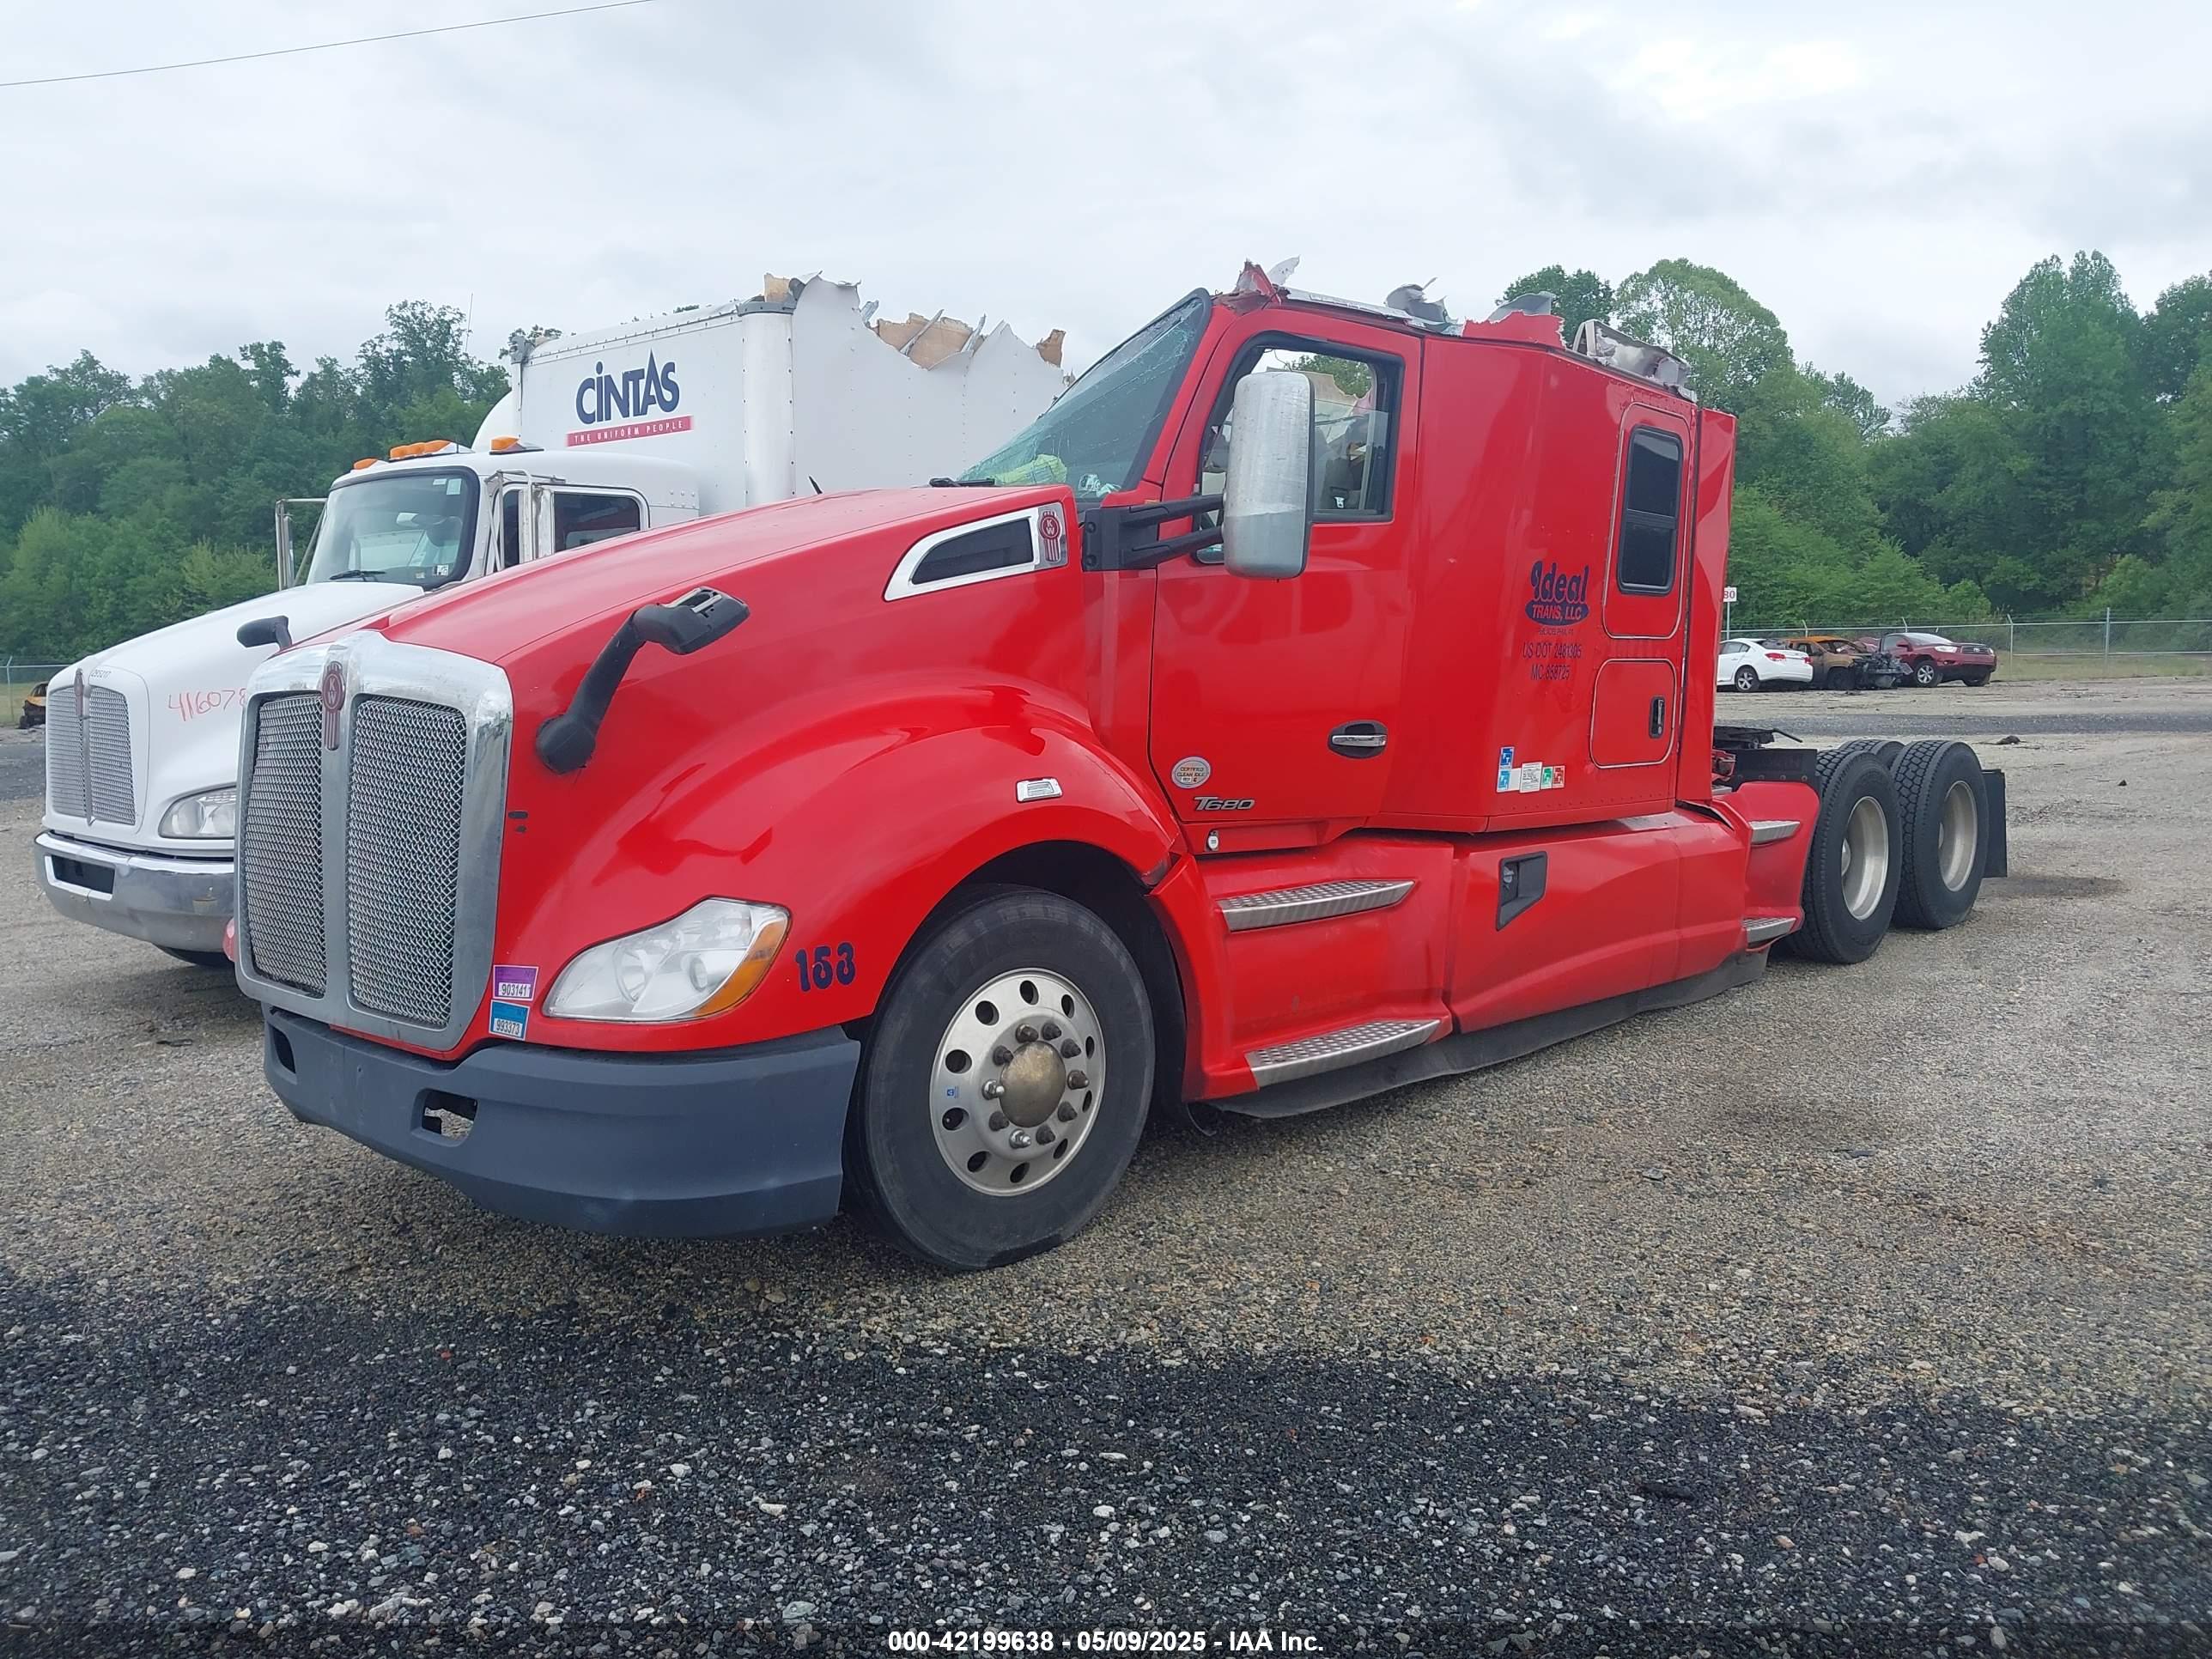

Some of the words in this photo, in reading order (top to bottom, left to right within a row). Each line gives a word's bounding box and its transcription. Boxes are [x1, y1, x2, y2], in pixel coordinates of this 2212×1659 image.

[574, 434, 591, 444] THE
[597, 427, 640, 441] UNIFORM
[646, 421, 683, 434] PEOPLE
[1531, 560, 1589, 602] Ideal
[1565, 605, 1583, 620] LLC
[1522, 641, 1534, 659] US
[1535, 641, 1553, 659] DOT
[1531, 663, 1544, 680] MC
[1194, 796, 1255, 811] T680
[501, 983, 527, 995] 903141
